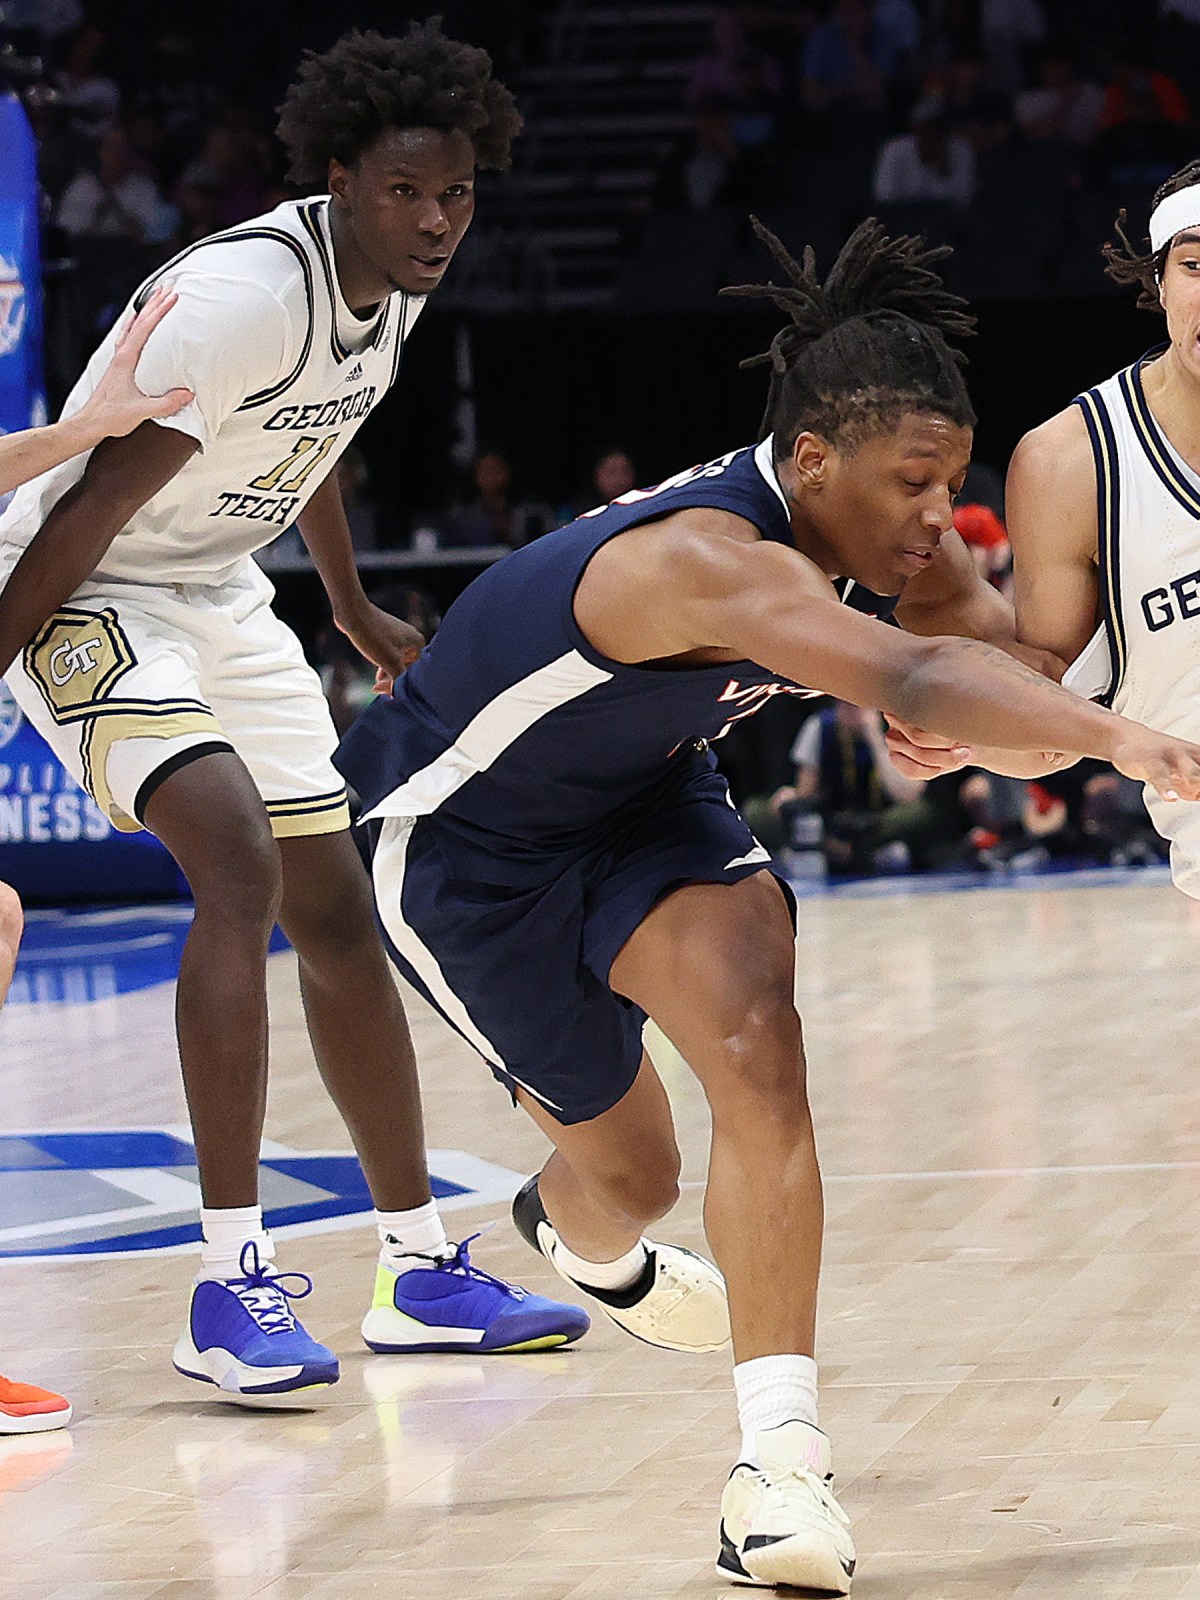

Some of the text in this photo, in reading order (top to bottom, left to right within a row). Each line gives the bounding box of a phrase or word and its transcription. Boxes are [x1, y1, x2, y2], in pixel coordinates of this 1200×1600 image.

[262, 385, 376, 430] GEORGIA
[247, 432, 341, 493] 11
[208, 492, 301, 524] TECH
